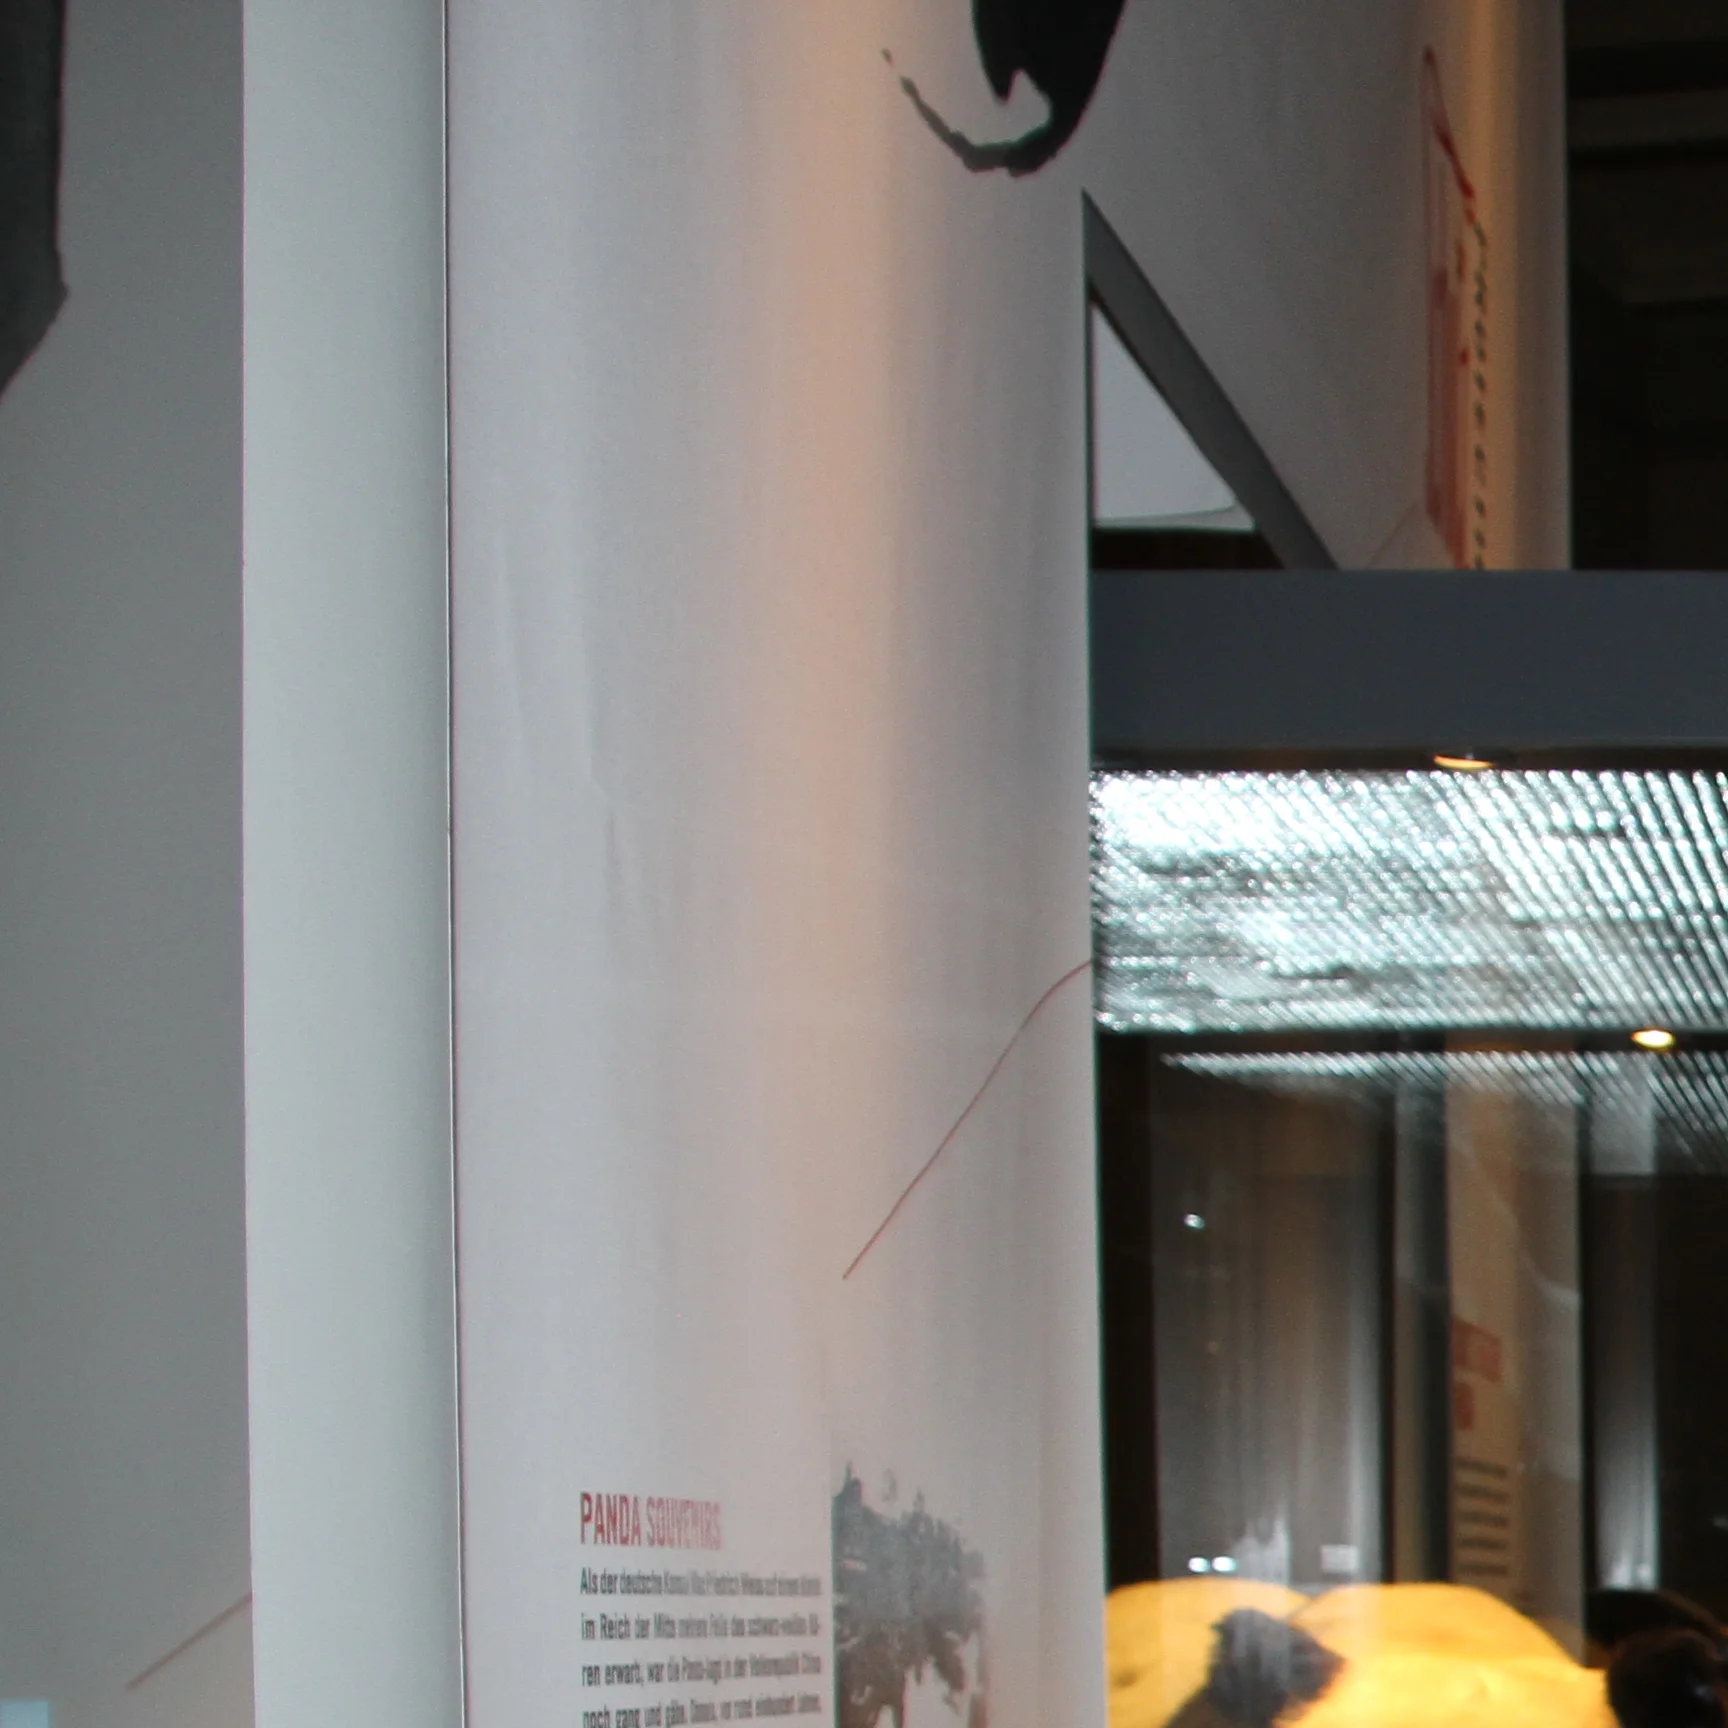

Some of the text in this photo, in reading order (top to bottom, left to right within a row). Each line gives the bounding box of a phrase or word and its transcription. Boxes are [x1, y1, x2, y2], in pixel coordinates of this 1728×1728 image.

[580, 1491, 721, 1551] PANDA SOUVENIRS
[580, 1567, 598, 1595] Als
[600, 1568, 618, 1595] der
[619, 1568, 662, 1595] deutsche
[581, 1612, 596, 1640] im
[600, 1612, 631, 1640] Reich
[582, 1664, 600, 1687] ren
[647, 1661, 664, 1683] war
